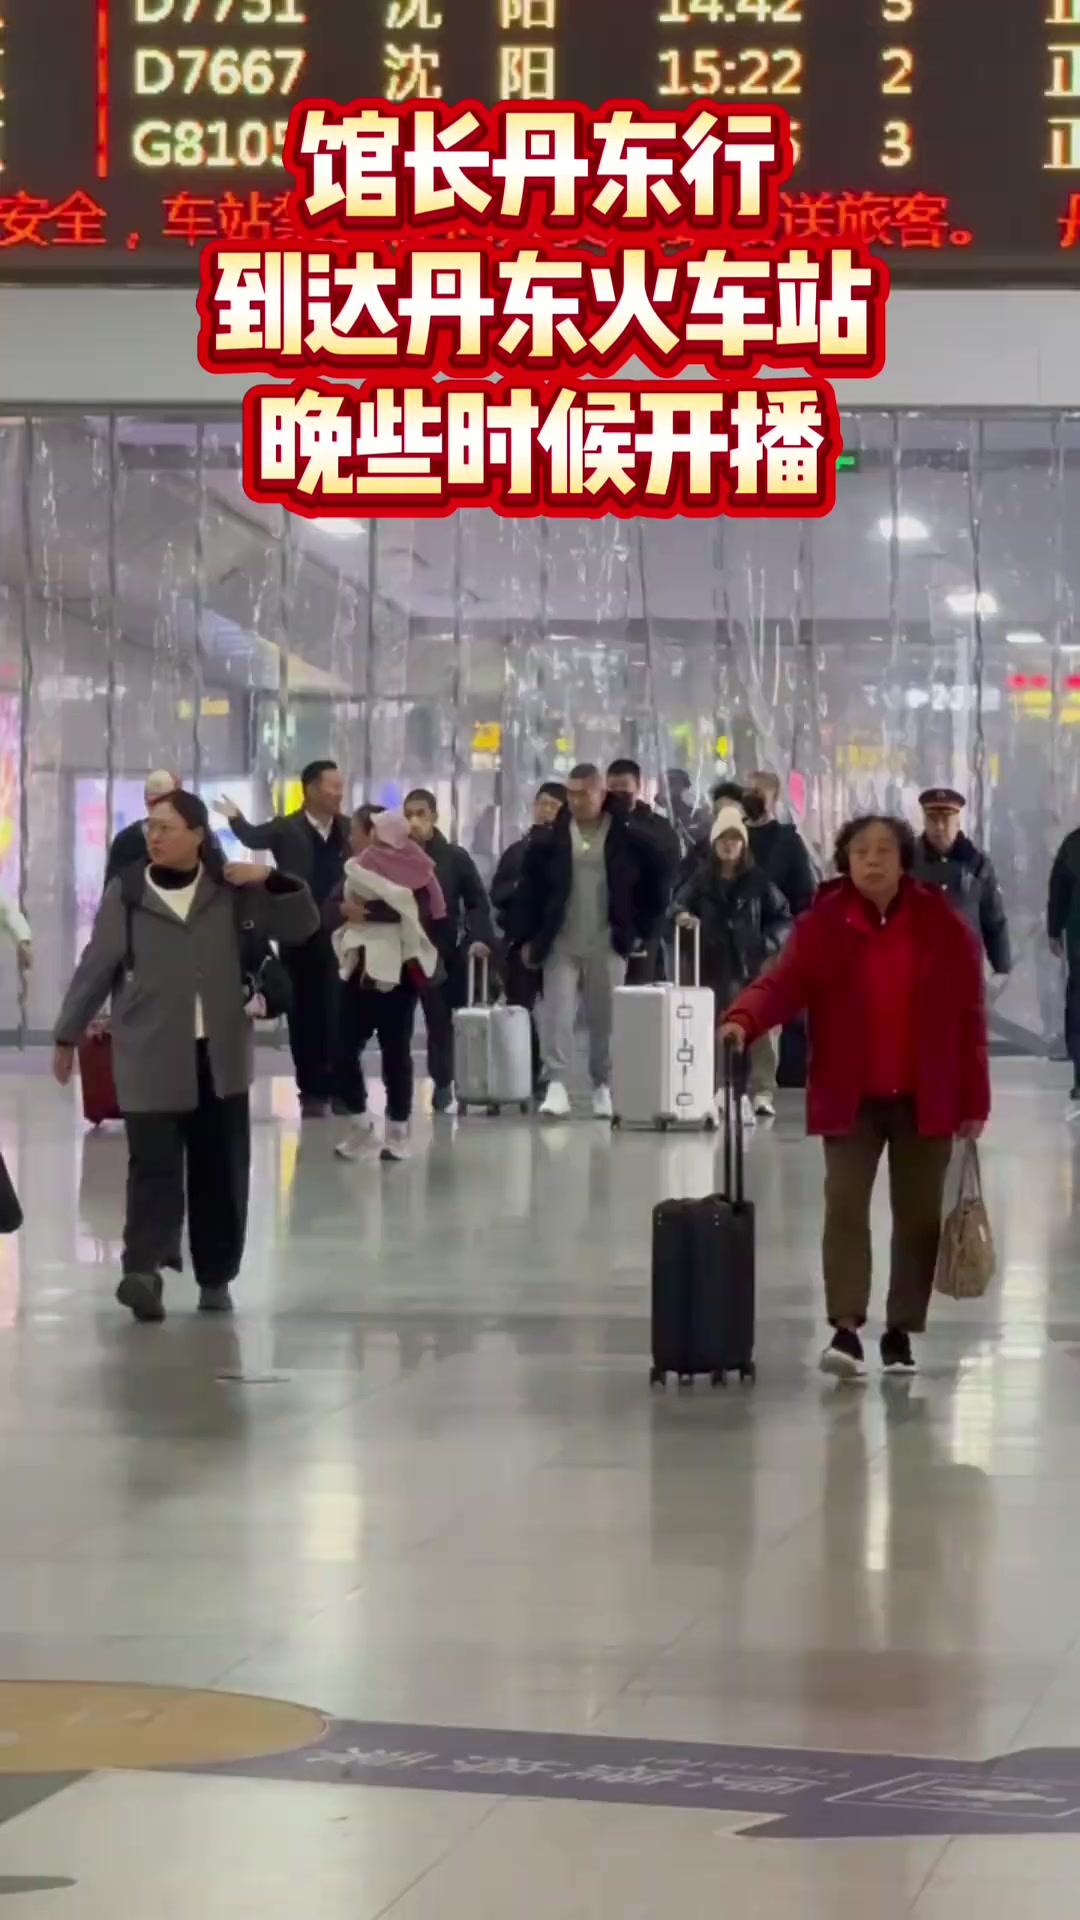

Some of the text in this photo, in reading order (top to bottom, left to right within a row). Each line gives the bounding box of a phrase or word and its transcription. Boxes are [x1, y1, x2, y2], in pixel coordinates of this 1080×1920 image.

[135, 49, 306, 95] D7667
[384, 43, 443, 101] 沈
[500, 46, 556, 101] 阳
[657, 49, 803, 95] 15:22
[881, 49, 913, 94] 2
[880, 120, 912, 167] 3
